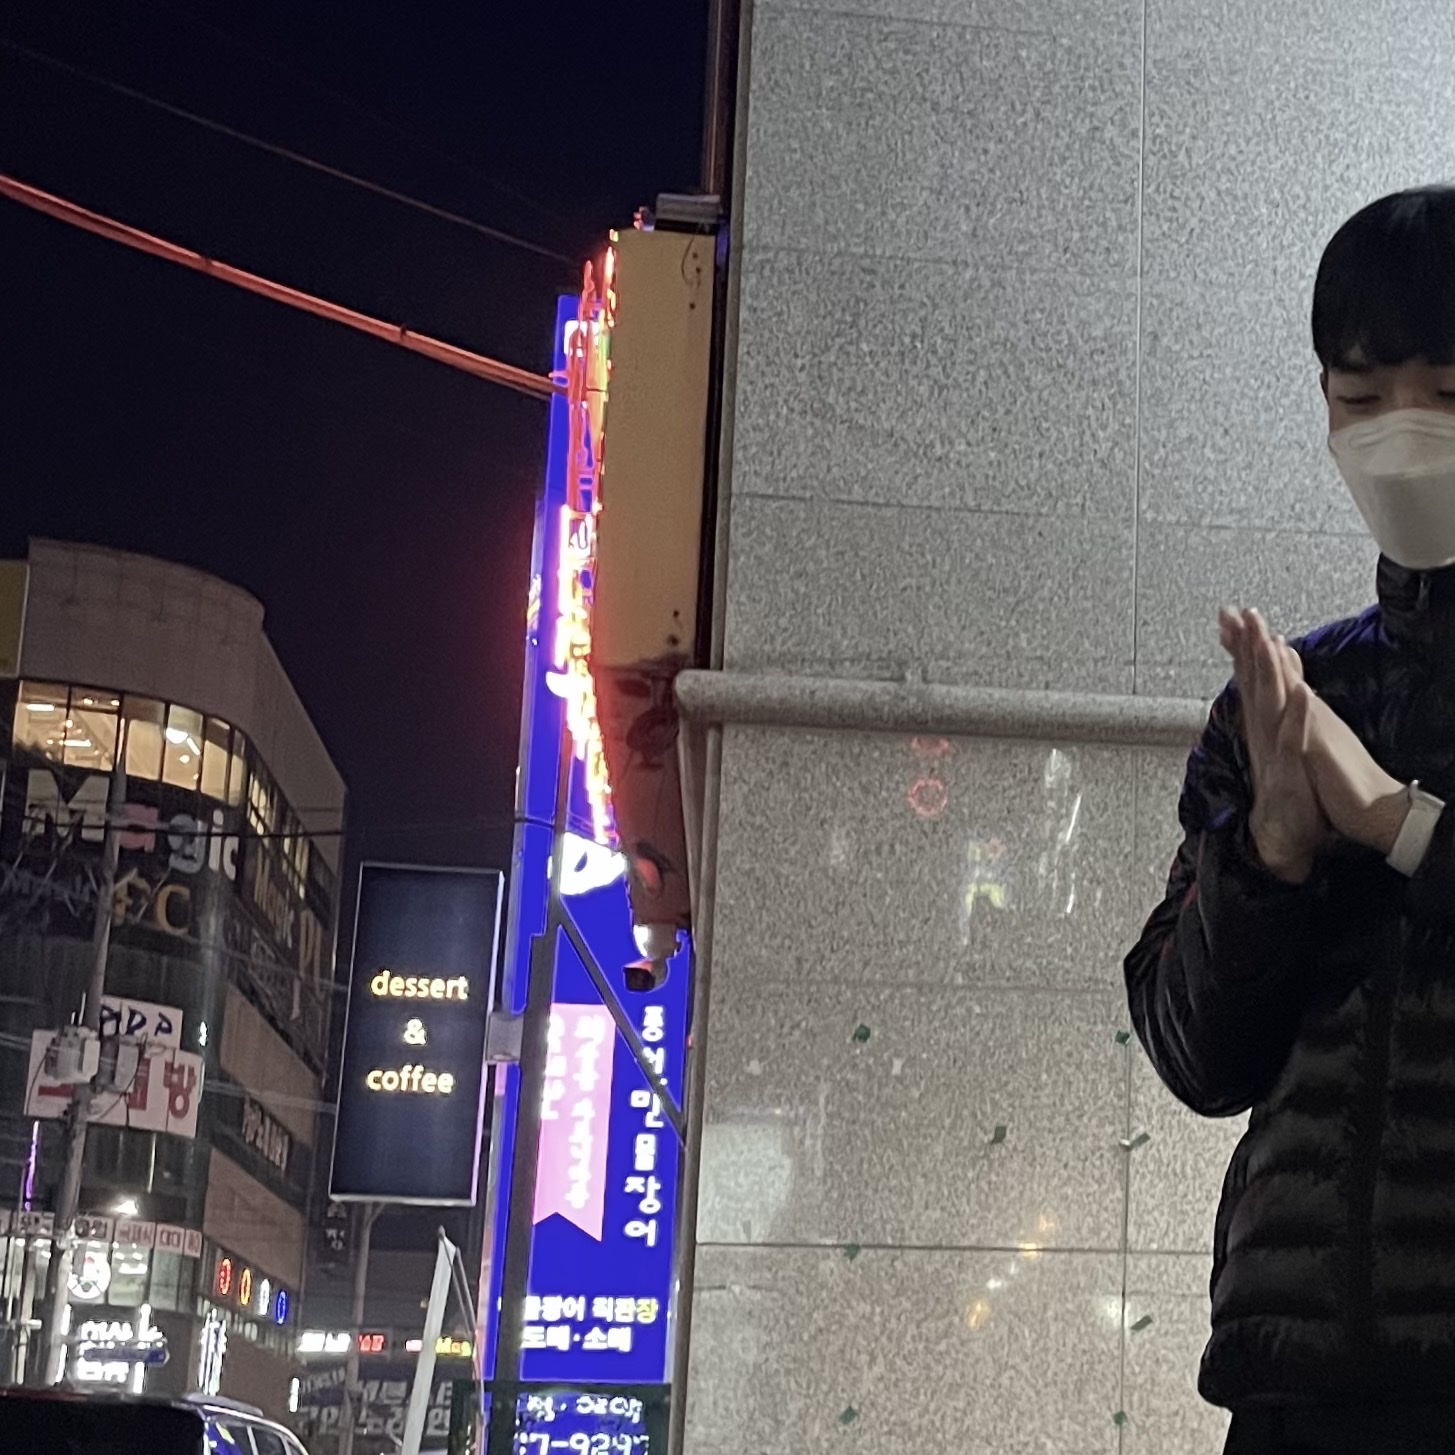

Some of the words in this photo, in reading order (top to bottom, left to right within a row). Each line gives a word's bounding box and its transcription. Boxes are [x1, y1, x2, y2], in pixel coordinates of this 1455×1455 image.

[370, 969, 470, 1001] dessert
[403, 1017, 427, 1046] &
[365, 1064, 455, 1094] coffee
